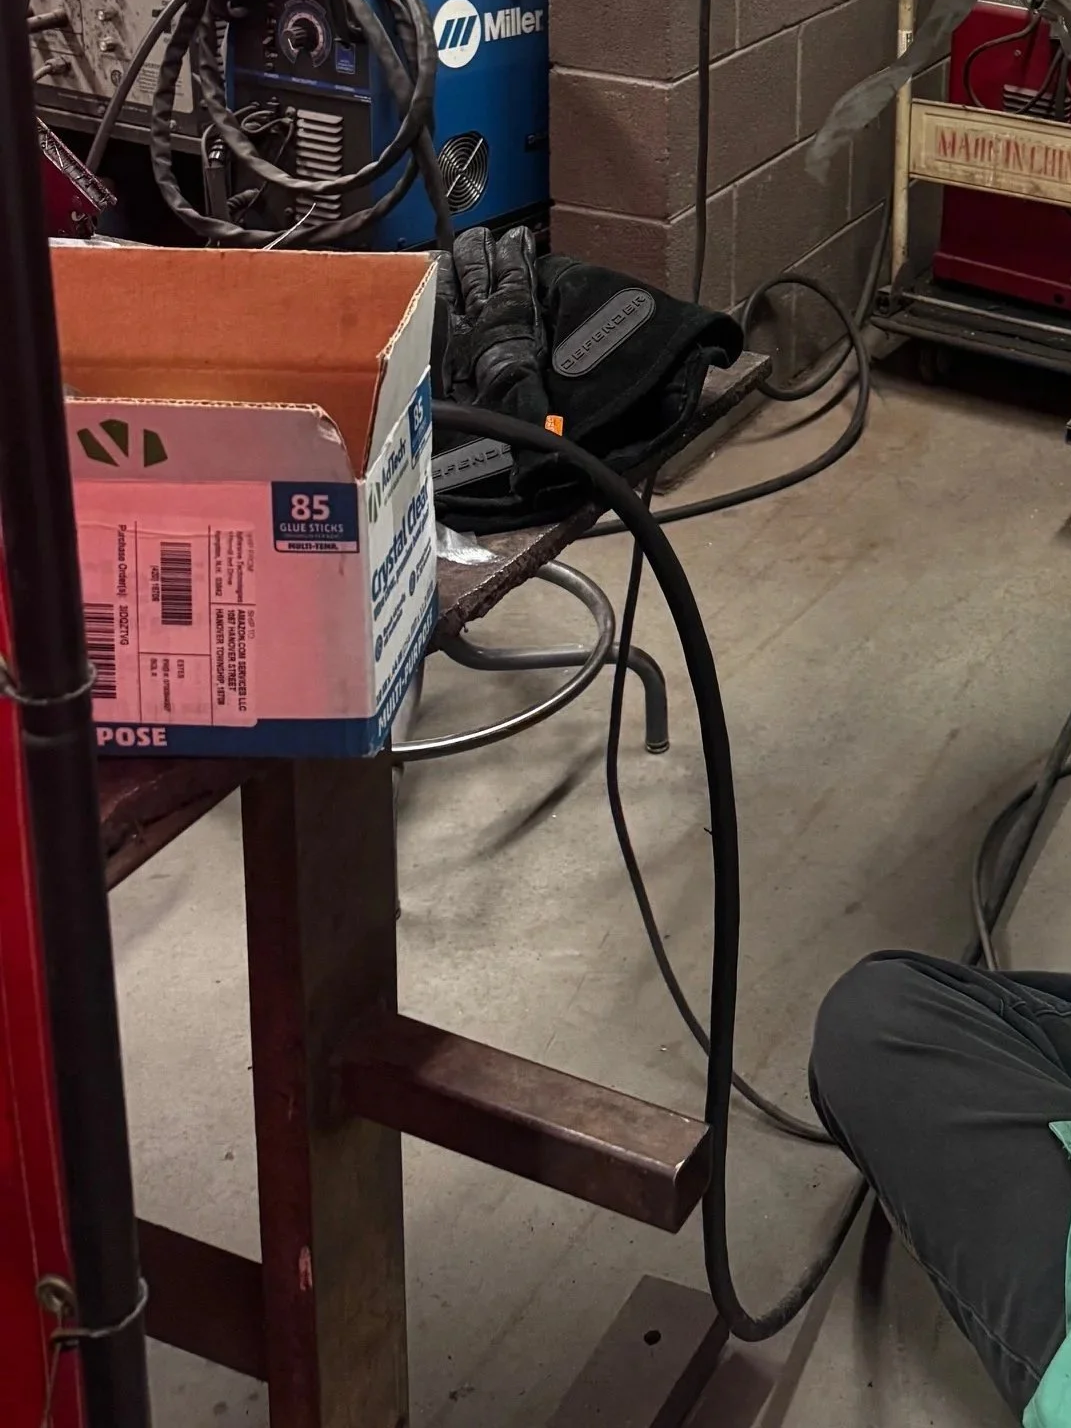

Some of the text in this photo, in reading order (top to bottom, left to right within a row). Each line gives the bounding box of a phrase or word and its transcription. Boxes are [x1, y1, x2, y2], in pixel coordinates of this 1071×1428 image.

[484, 7, 544, 42] Miller
[560, 296, 646, 369] DEFENDER
[414, 396, 424, 431] 85
[381, 439, 406, 492] AdTech
[432, 444, 512, 479] EFENDE
[291, 494, 330, 521] 85
[117, 524, 128, 562] Purchase
[280, 522, 344, 533] GLUE STICKS
[372, 518, 408, 602] Crystal
[407, 476, 429, 531] Clear
[215, 609, 225, 645] HANOVER
[228, 626, 236, 662] HANOVER
[228, 663, 237, 692] STREET
[237, 609, 247, 712] AMAZON.COM SERVICES LLC
[378, 608, 433, 737] MULTI-PURPOSE
[96, 726, 168, 747] POSE
